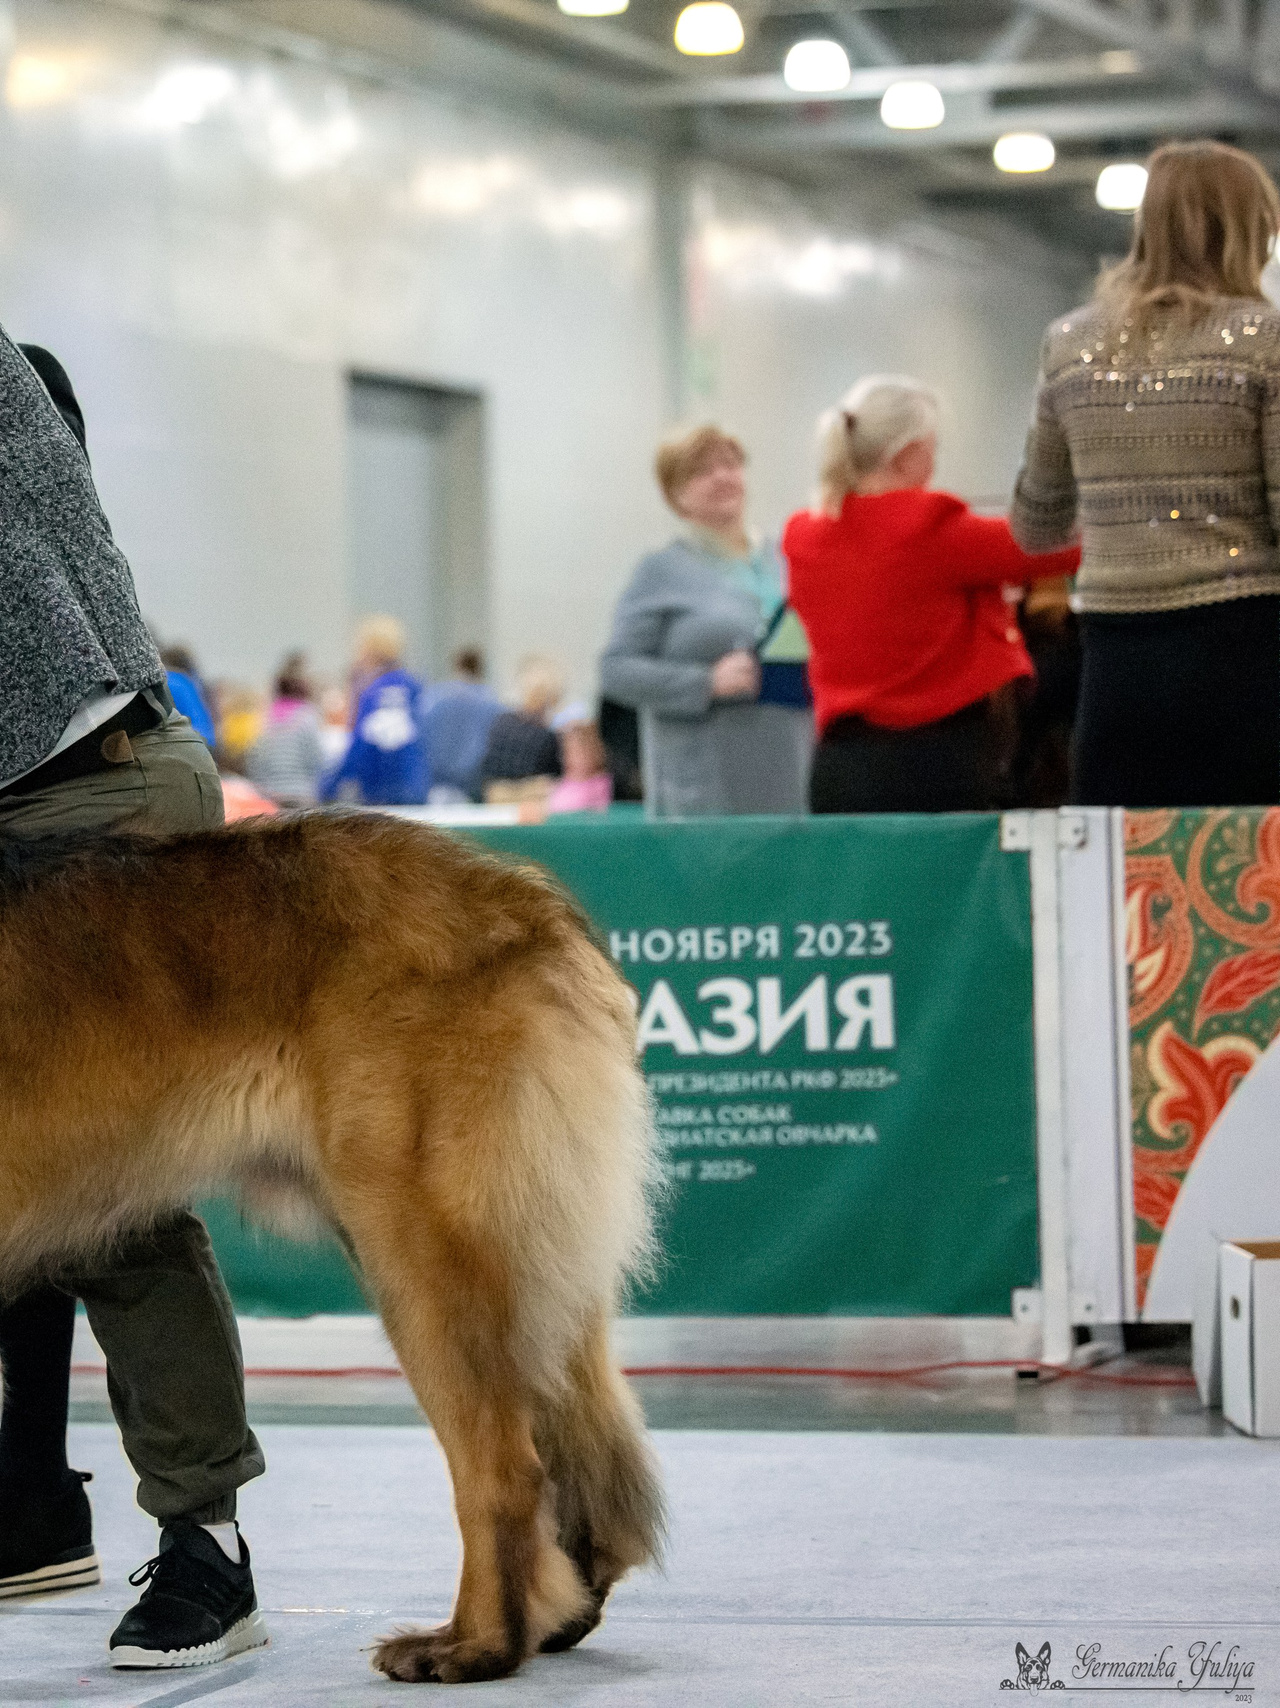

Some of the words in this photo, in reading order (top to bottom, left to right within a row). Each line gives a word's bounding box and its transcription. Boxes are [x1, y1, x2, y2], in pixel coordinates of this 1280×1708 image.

[609, 925, 780, 963] НОЯБРЯ
[794, 920, 892, 958] 2023
[636, 973, 896, 1055] АЗИЯ
